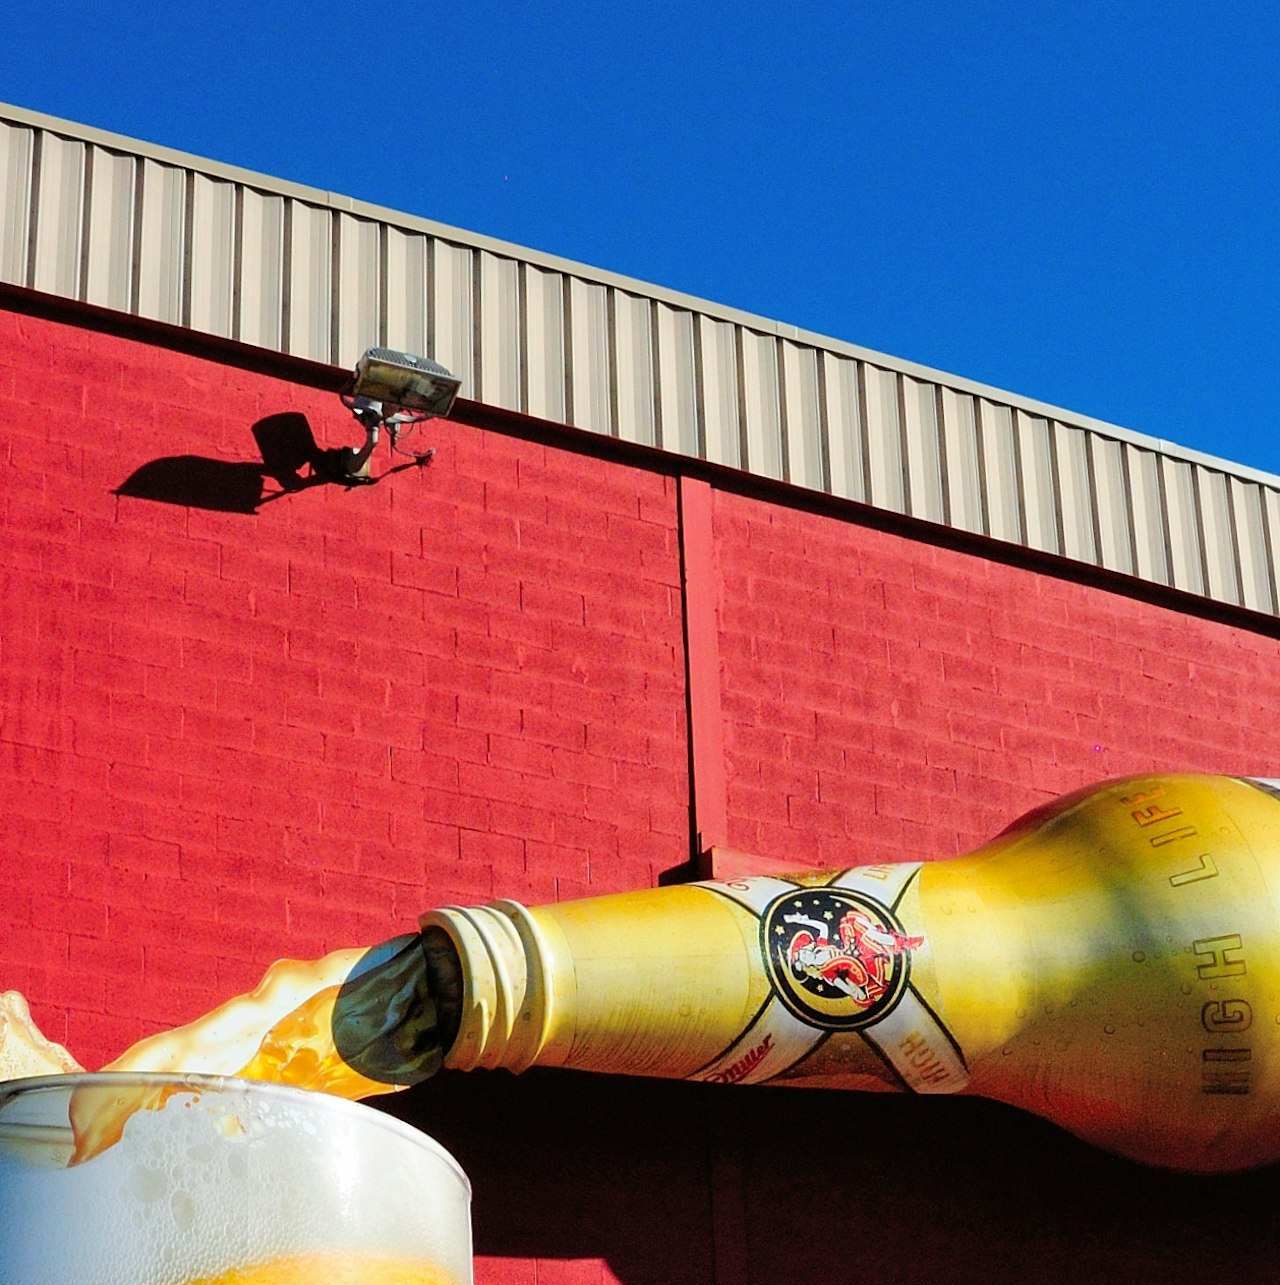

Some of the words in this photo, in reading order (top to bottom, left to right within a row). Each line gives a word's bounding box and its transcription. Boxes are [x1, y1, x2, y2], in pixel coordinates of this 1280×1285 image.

[1121, 785, 1219, 888] LIFE
[1192, 933, 1253, 1095] HIGH
[704, 1033, 776, 1084] Miller
[899, 1032, 950, 1085] HIGH
